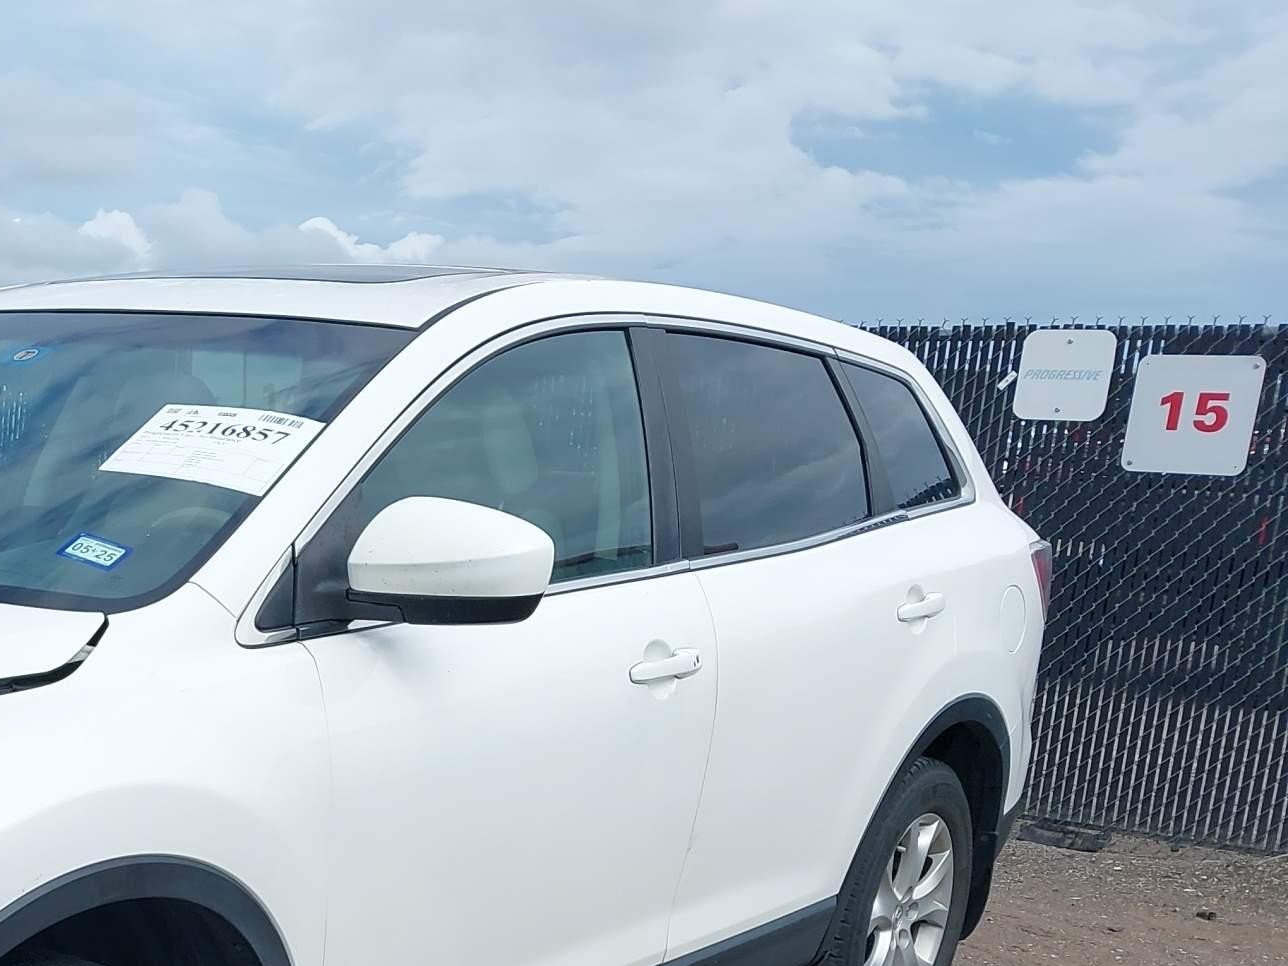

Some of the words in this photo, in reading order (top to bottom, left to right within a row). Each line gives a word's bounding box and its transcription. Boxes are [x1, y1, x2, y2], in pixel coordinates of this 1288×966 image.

[1024, 369, 1102, 381] PROGRESSIVE
[1160, 392, 1231, 432] 15
[160, 419, 291, 444] 45216857
